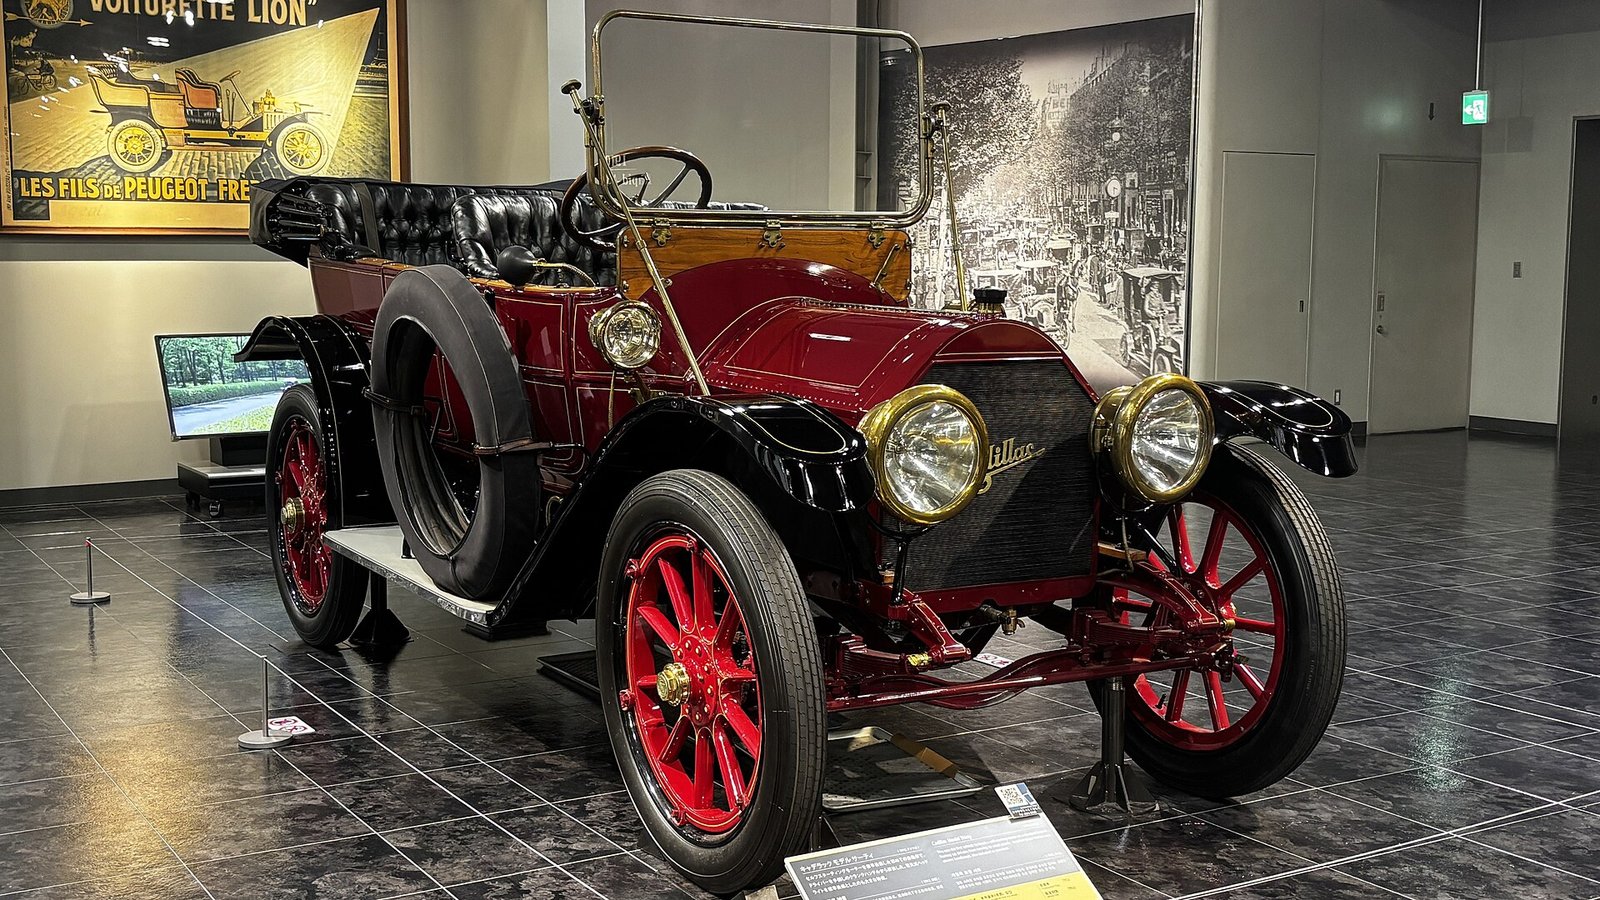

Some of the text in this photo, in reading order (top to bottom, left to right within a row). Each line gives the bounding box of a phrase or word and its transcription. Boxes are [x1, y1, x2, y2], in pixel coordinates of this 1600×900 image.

[20, 176, 260, 201] LES FILS DE PEUGEOT FRE
